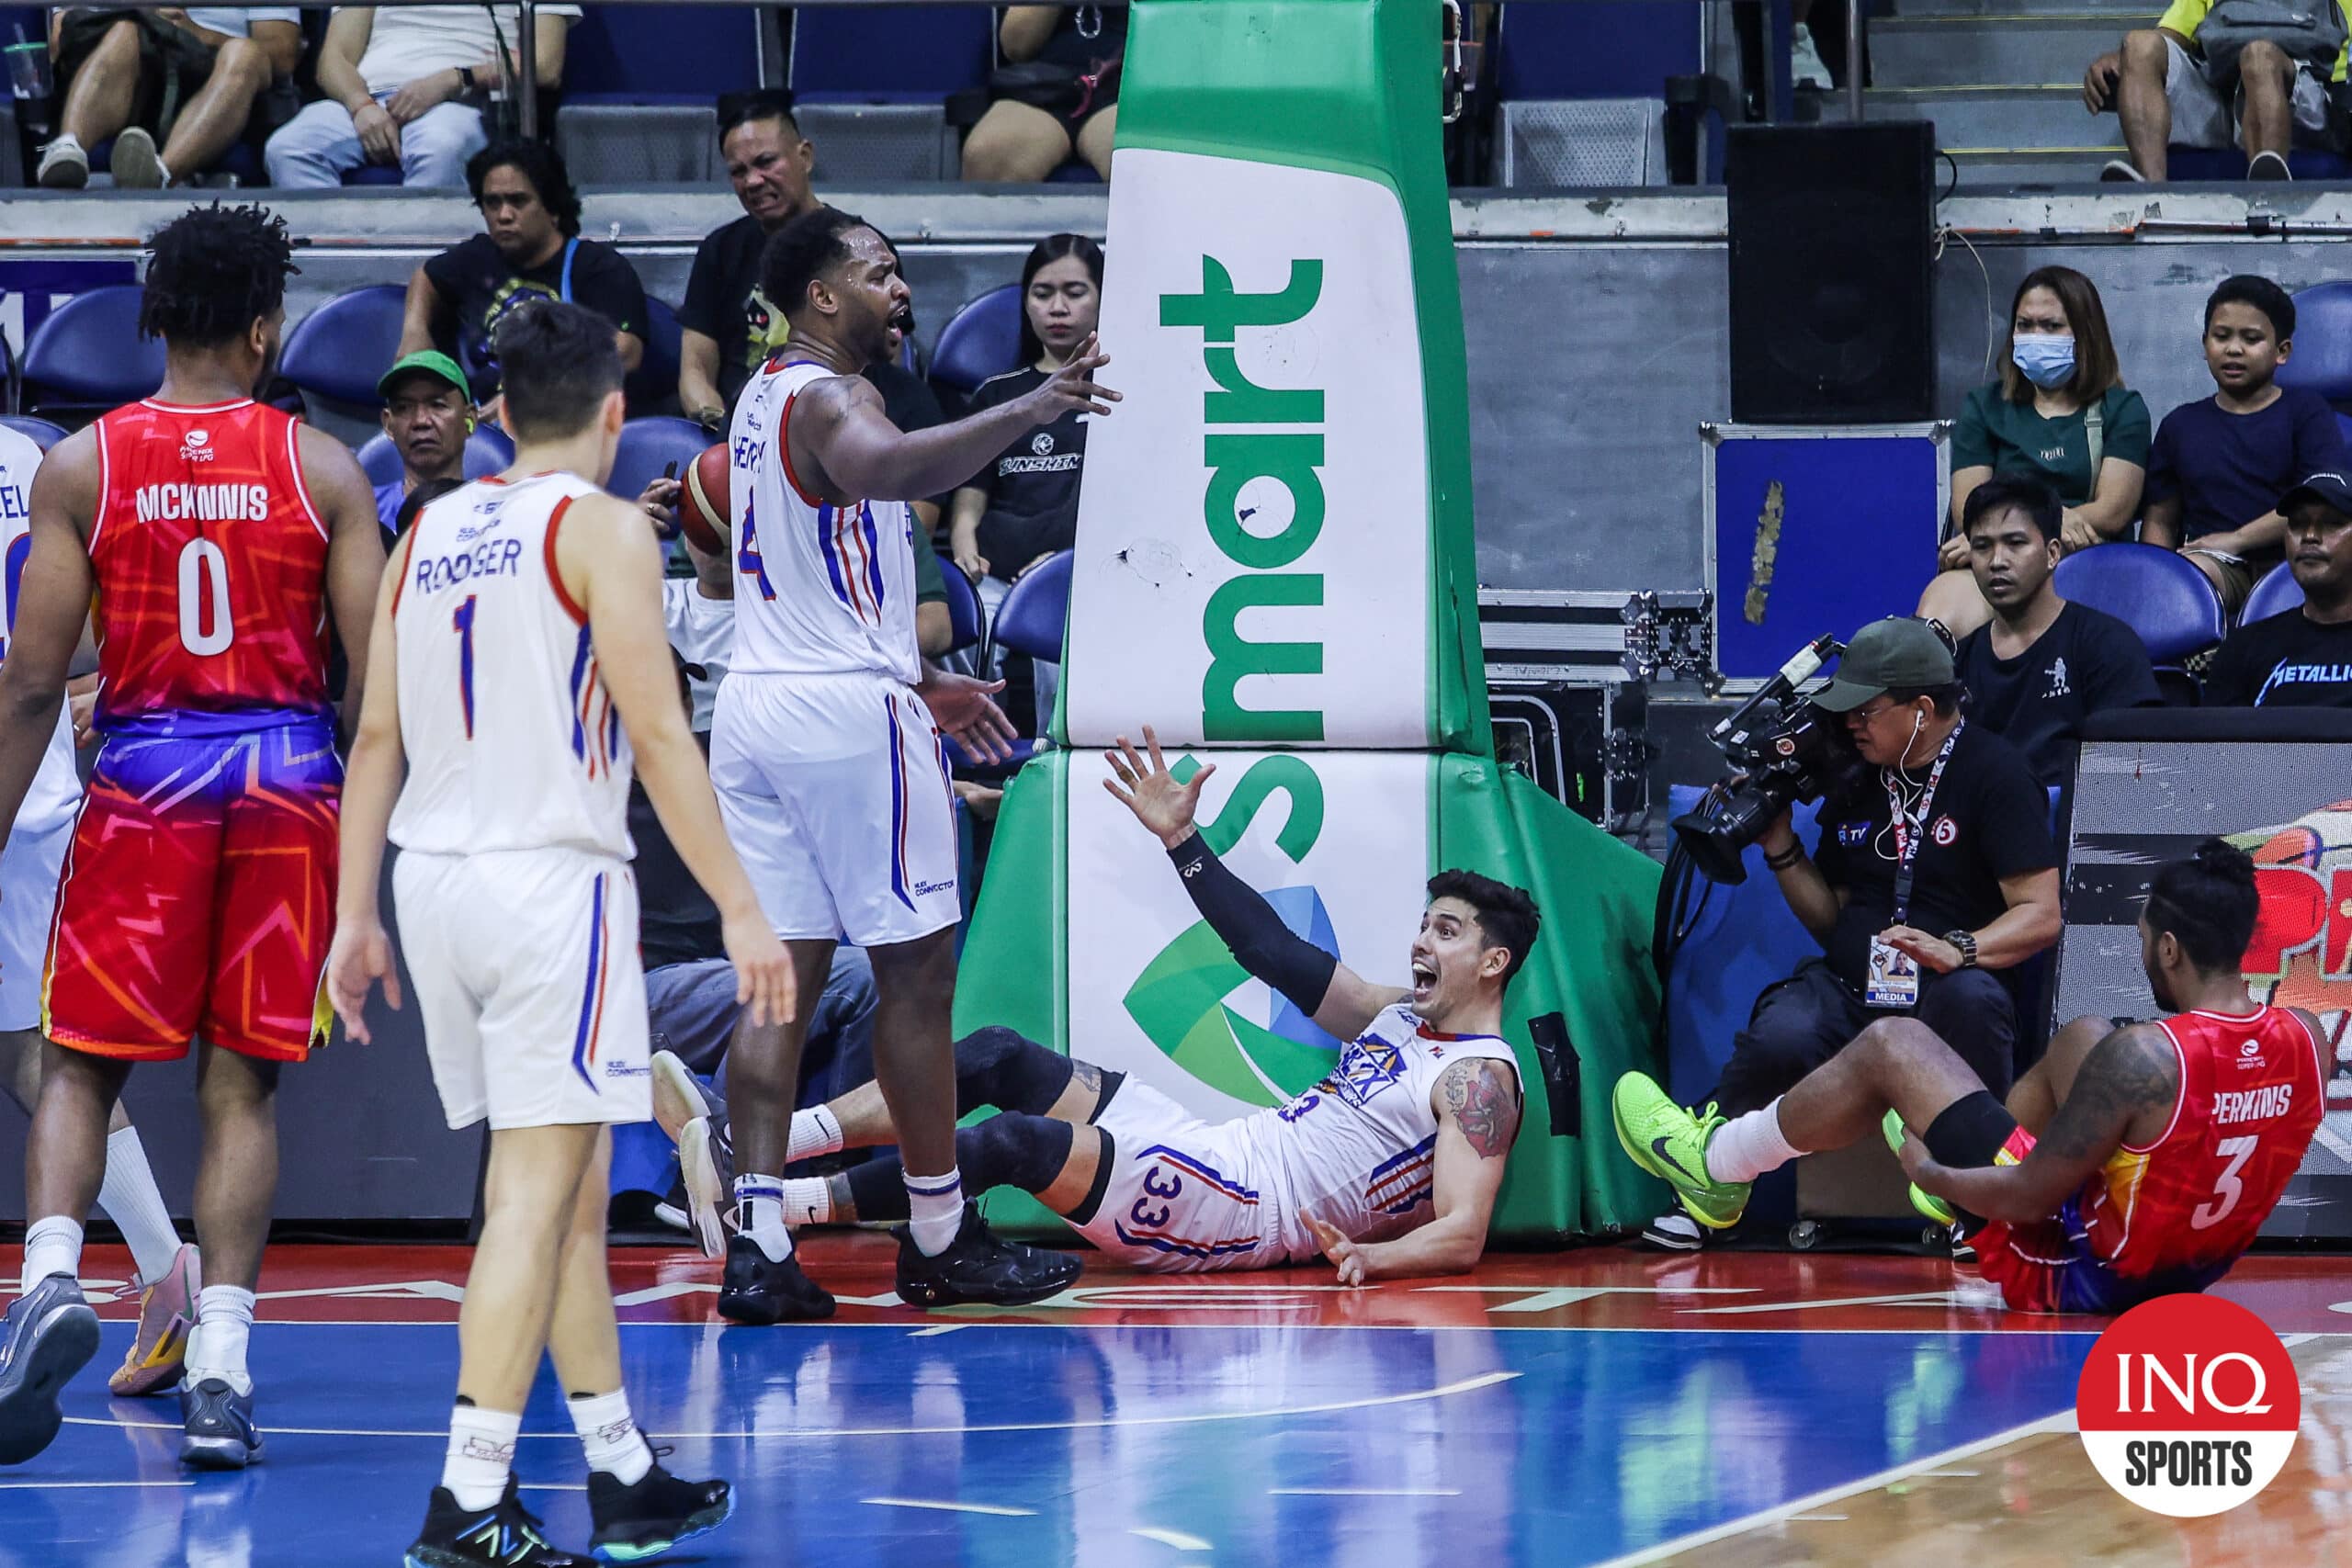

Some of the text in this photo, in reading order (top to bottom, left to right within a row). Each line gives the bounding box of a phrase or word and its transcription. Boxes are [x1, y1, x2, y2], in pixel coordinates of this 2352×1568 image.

[999, 453, 1082, 477] SUNSHIN
[136, 483, 268, 524] MCKNNIS
[1159, 254, 1325, 864] smart
[178, 536, 234, 657] 0
[453, 594, 477, 740] 1
[2254, 657, 2352, 707] METALLI
[1875, 992, 1906, 1001] MEDIA
[1130, 1166, 1182, 1228] 33
[2190, 1135, 2259, 1230] 3
